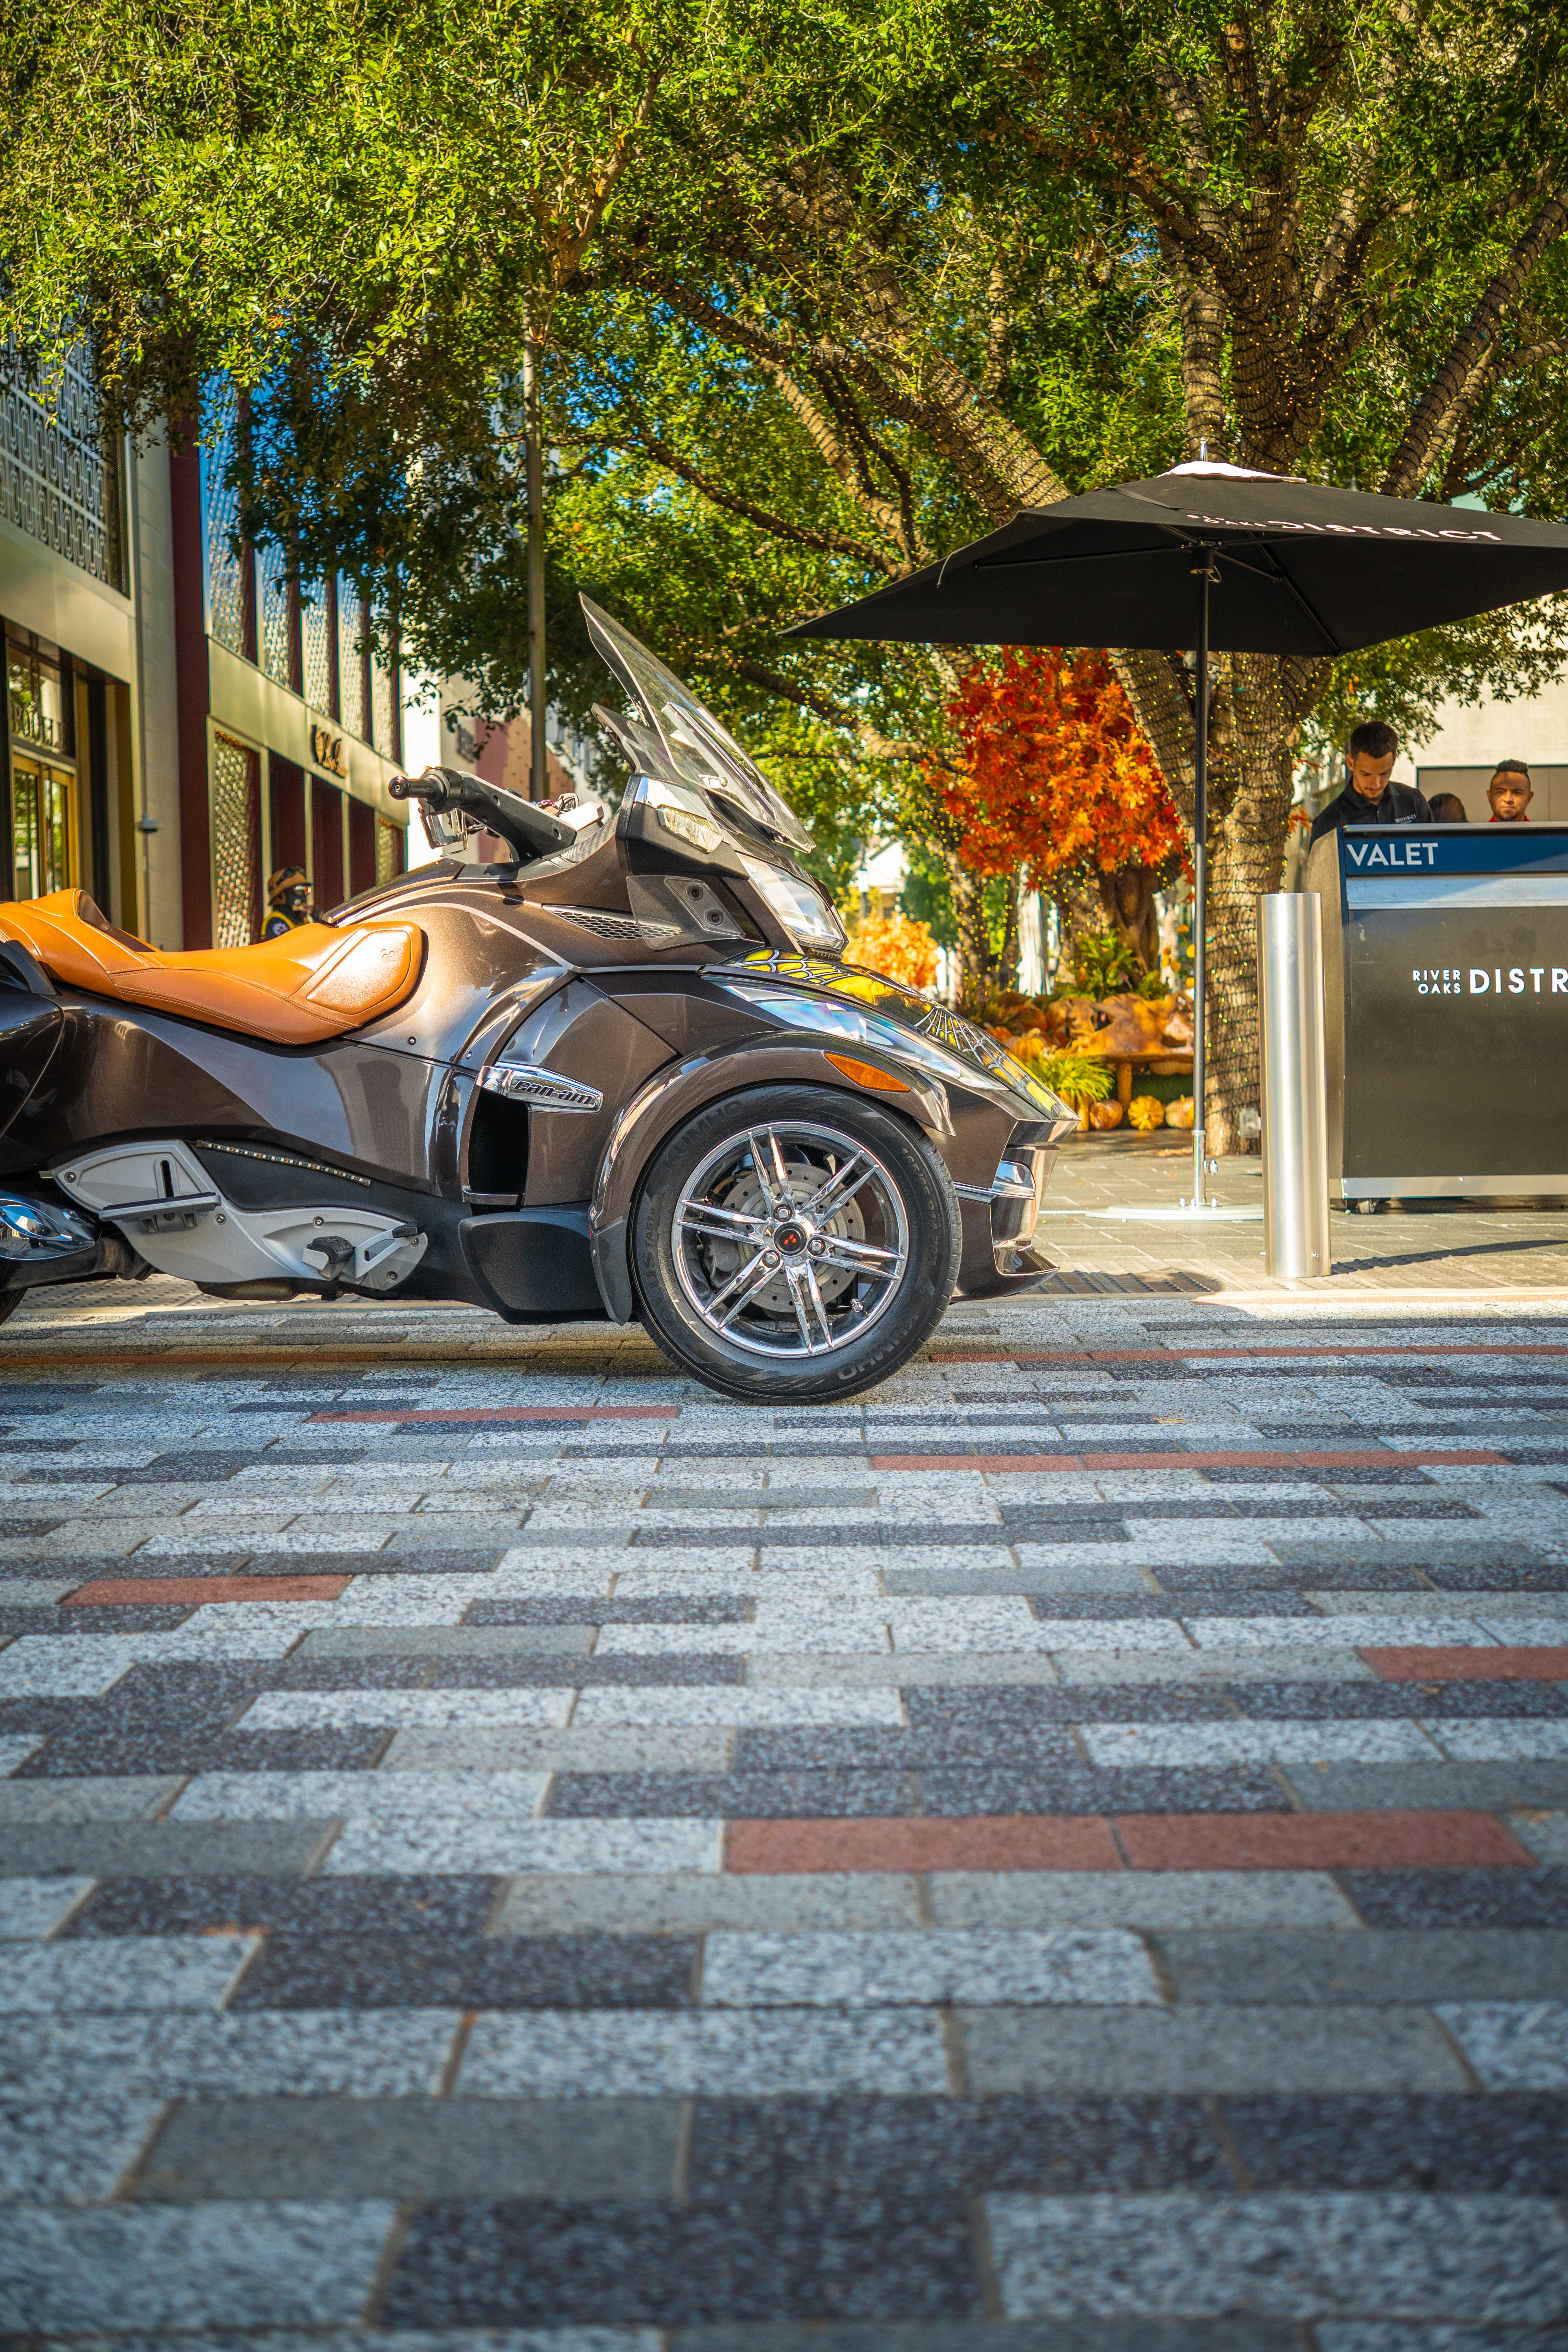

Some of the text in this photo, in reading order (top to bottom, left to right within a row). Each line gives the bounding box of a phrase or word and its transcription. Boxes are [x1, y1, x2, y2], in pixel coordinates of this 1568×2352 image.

[1267, 520, 1502, 541] DISTRICT
[1347, 842, 1438, 866] VALET
[1412, 969, 1461, 982] RIVER
[1418, 967, 1568, 995] OAKS DISTR
[514, 1080, 595, 1105] can-am
[660, 1098, 745, 1172] KUMHO
[898, 1148, 930, 1195] 165/65
[645, 1206, 657, 1248] TA51a
[923, 1200, 937, 1230] R14
[928, 1236, 938, 1265] 79T
[705, 1332, 743, 1358] OUTSIDE
[835, 1308, 920, 1381] KUMHO
